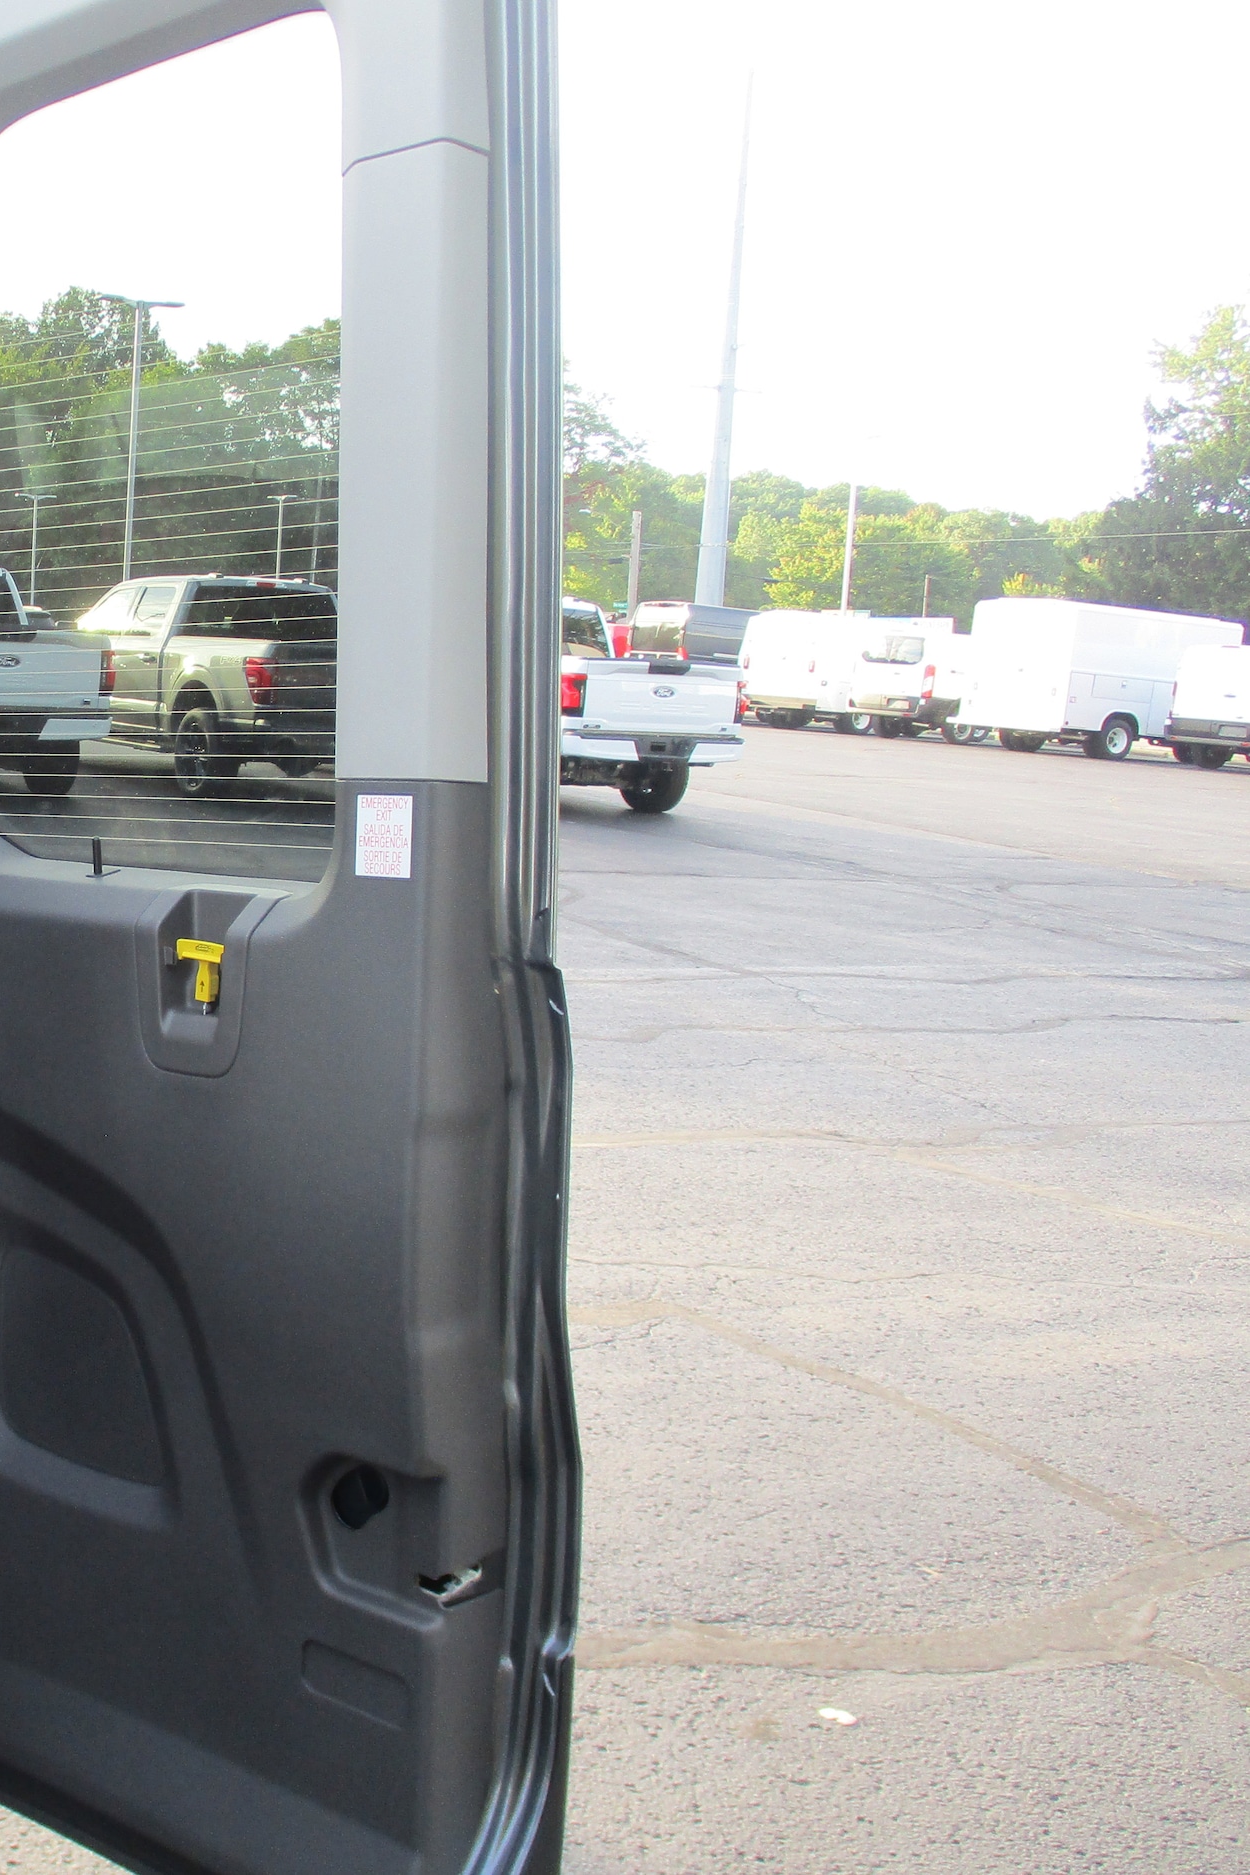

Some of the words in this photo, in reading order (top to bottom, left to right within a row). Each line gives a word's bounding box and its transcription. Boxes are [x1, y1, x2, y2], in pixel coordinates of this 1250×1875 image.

[361, 797, 408, 809] EMERGENCY
[376, 810, 392, 821] EXIT
[364, 824, 391, 835] SALIDA
[393, 825, 404, 836] DE
[359, 836, 408, 848] EMERGENCIA
[363, 850, 389, 862] SORTIE
[392, 852, 402, 863] DE
[364, 862, 401, 875] SECOURS
